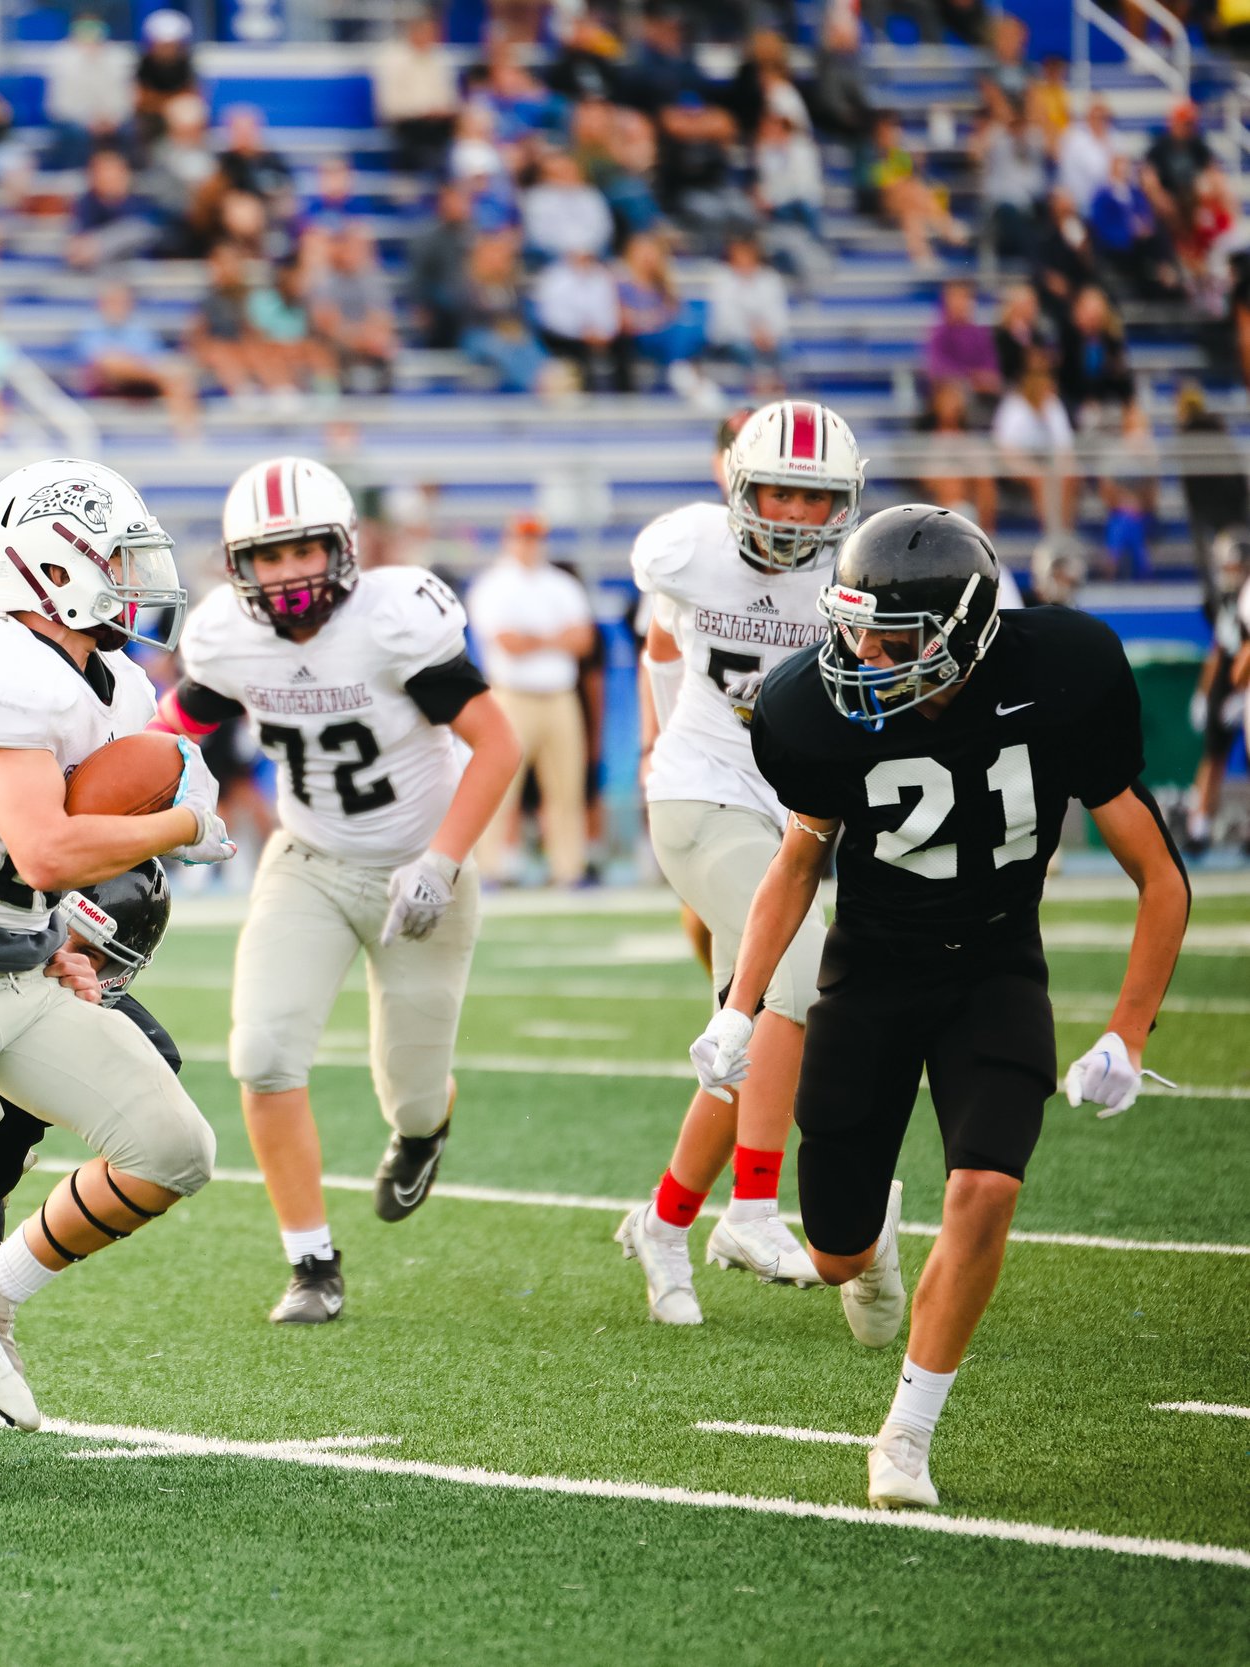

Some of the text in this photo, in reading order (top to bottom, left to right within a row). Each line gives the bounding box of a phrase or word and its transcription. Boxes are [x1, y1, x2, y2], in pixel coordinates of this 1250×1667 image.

[788, 462, 817, 472] Riddell
[746, 605, 780, 616] adidas
[244, 683, 373, 715] CENTENNIAL
[258, 720, 398, 816] 72
[864, 743, 1038, 880] 21
[77, 899, 108, 926] Riddell
